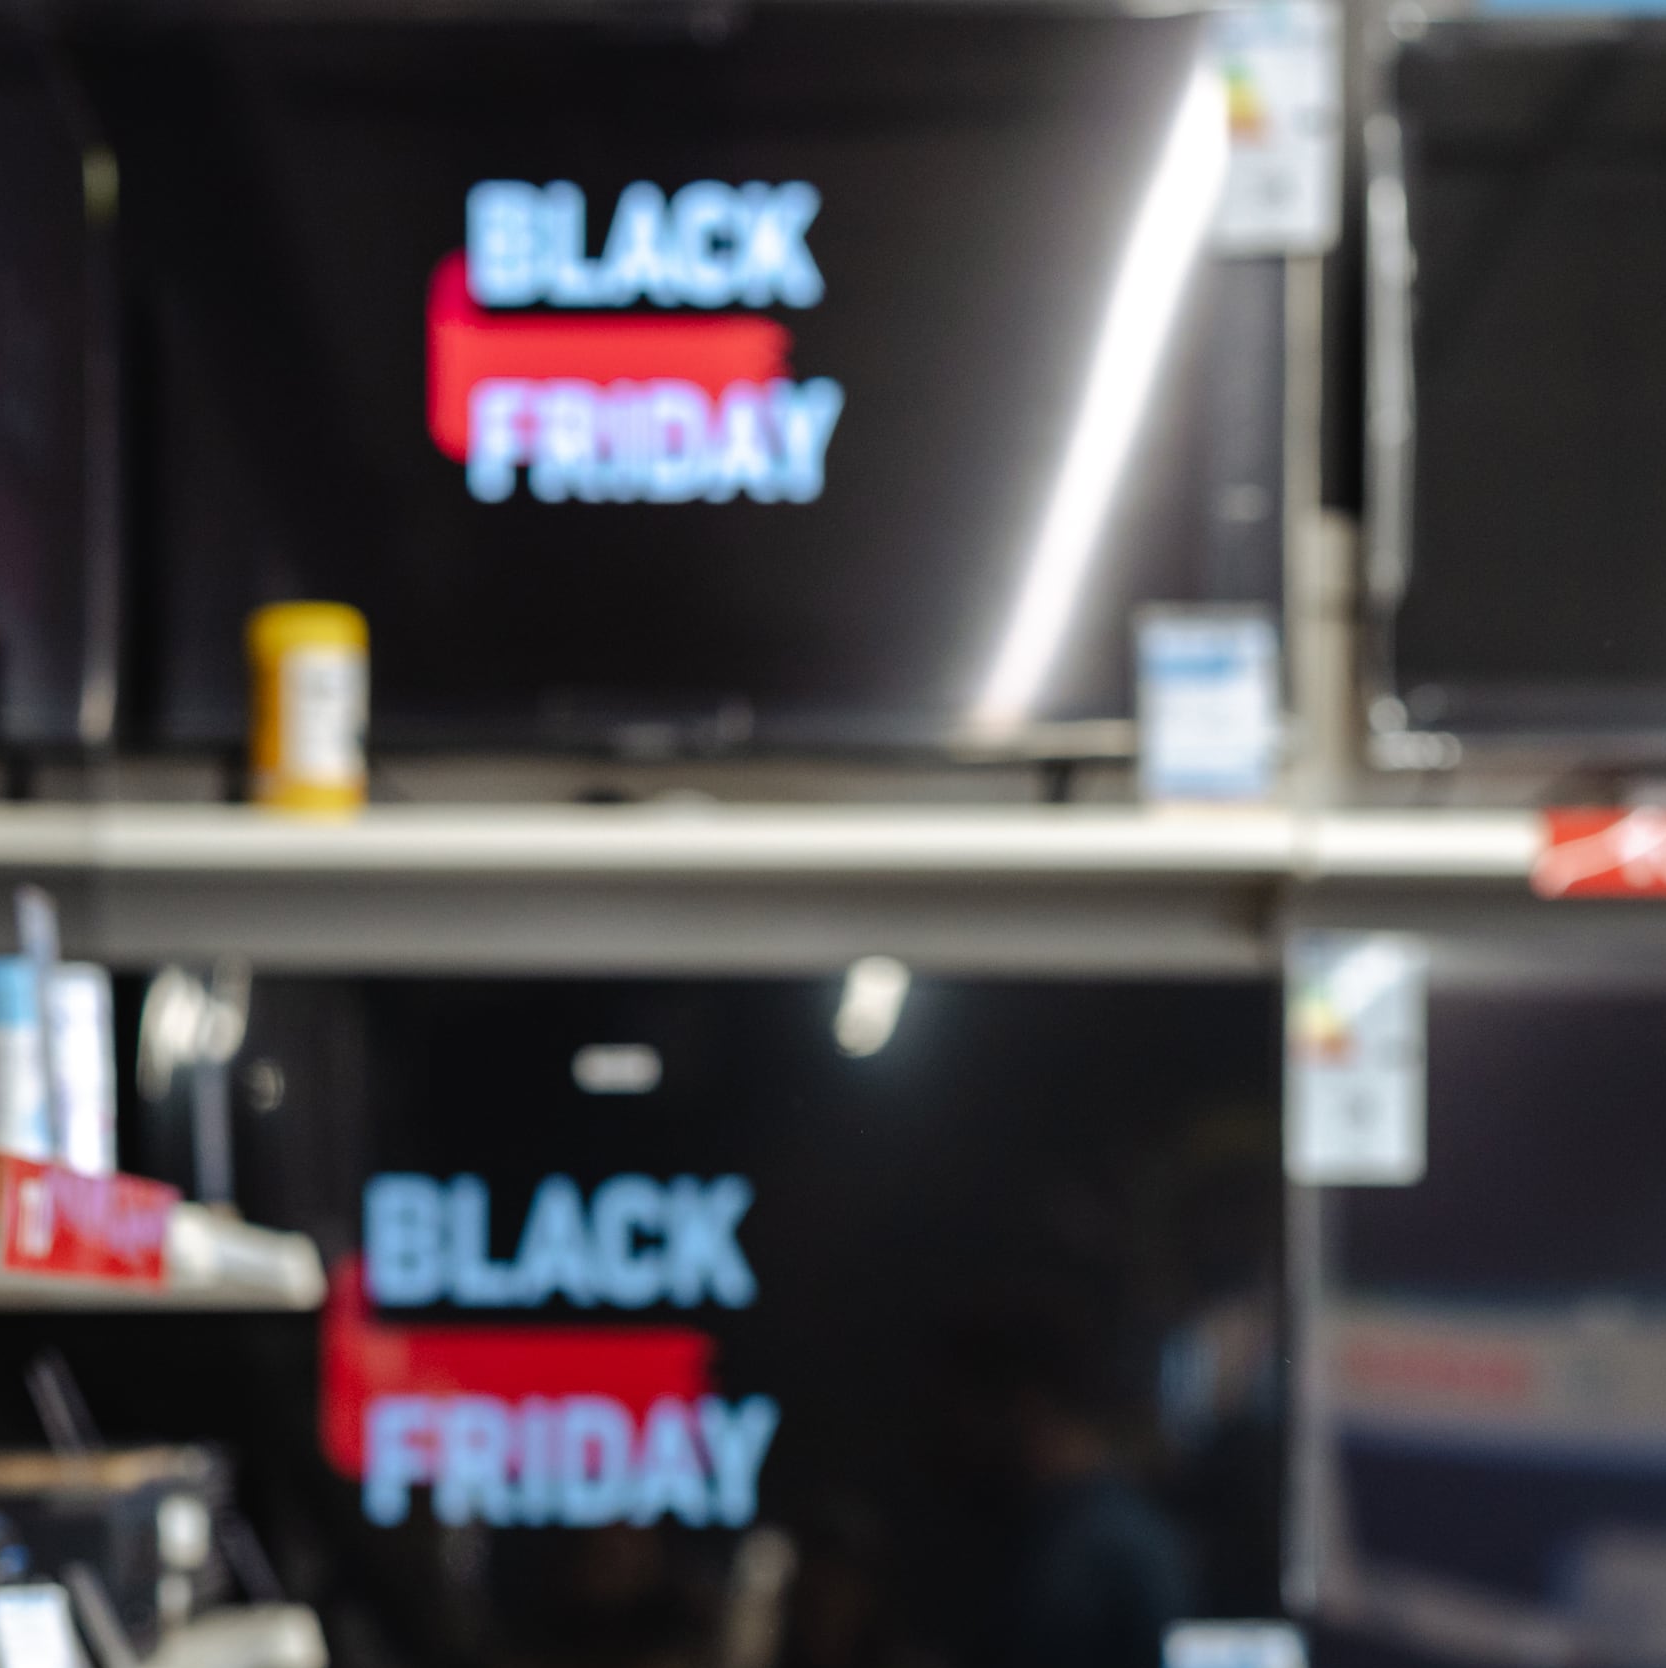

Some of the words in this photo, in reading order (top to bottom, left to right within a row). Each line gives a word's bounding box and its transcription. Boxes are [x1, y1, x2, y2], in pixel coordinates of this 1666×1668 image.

[467, 180, 824, 309] BLACK
[467, 377, 843, 503] FRIDAY
[364, 1174, 757, 1308] BLACK
[364, 1394, 780, 1527] FRIDAY
